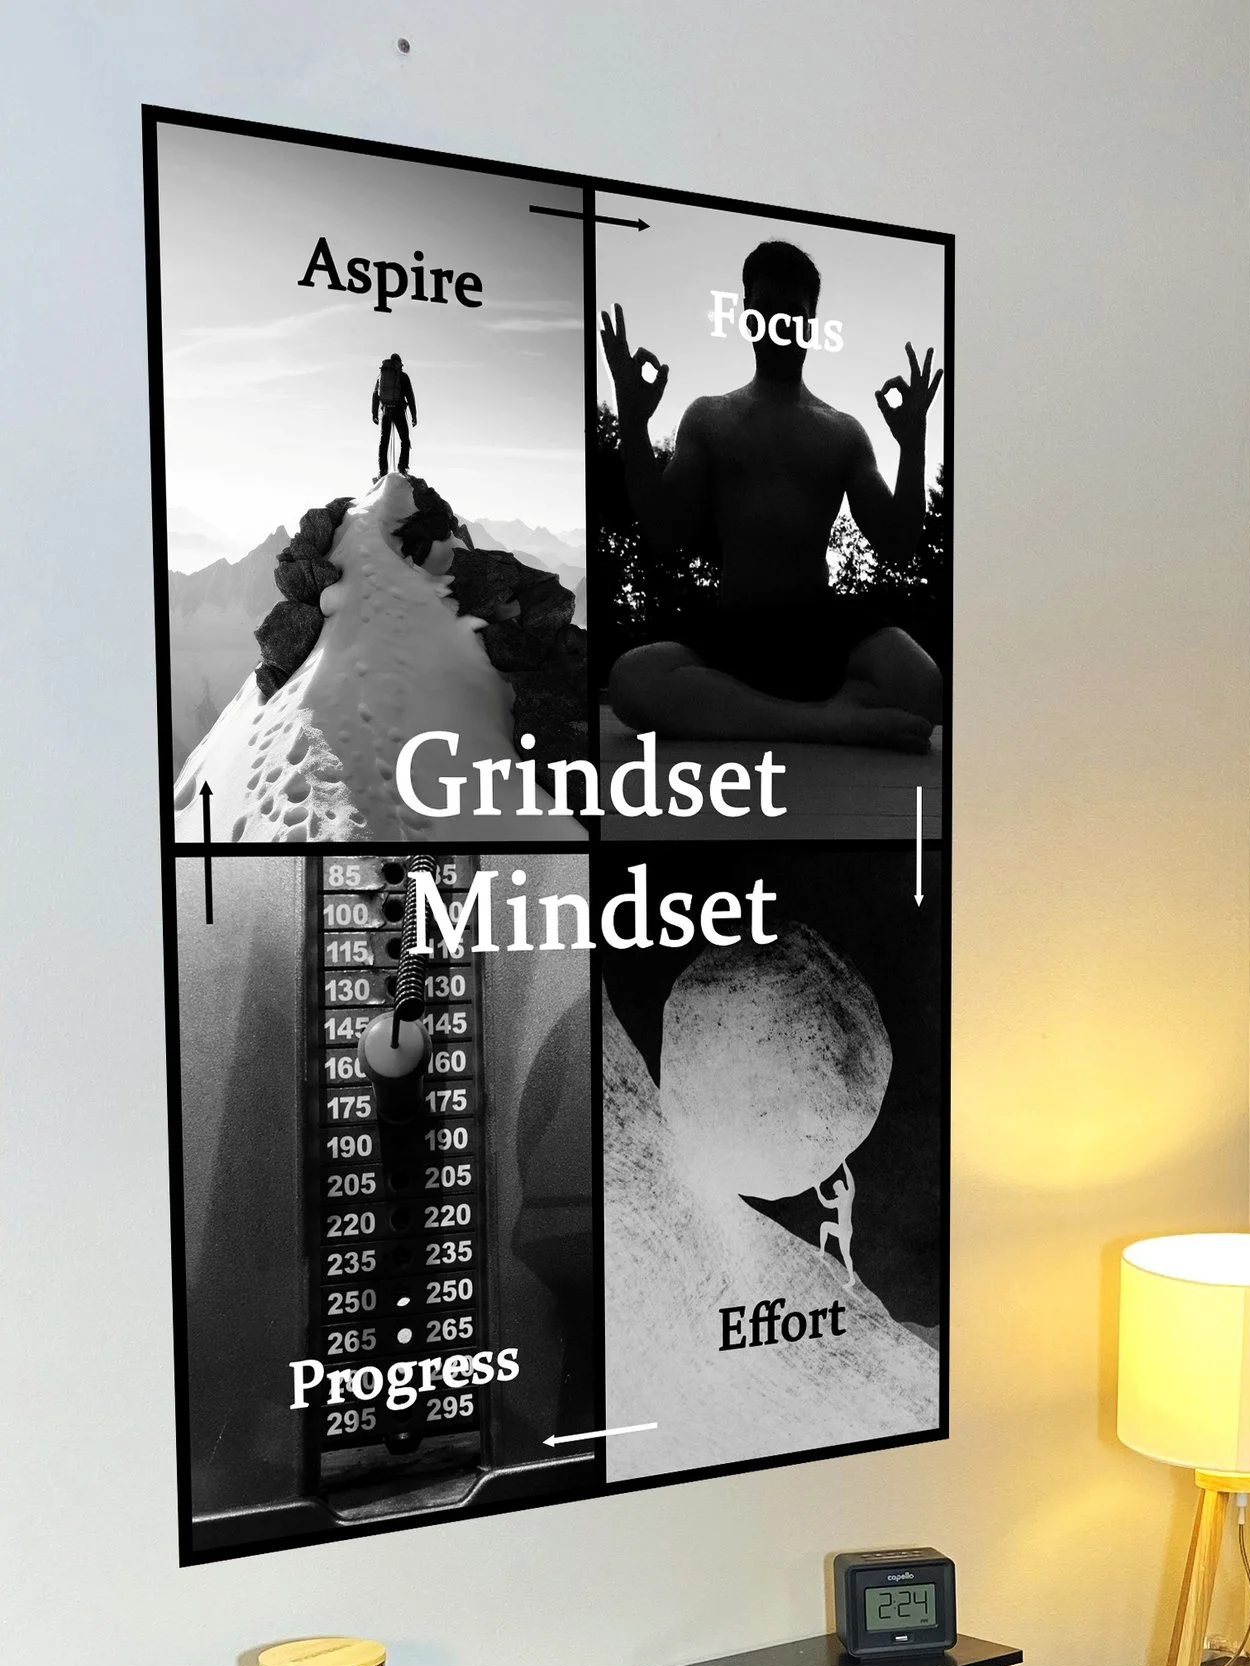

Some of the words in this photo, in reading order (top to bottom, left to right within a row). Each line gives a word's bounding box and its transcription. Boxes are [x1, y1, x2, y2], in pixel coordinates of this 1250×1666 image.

[298, 237, 483, 312] Aspire
[709, 290, 845, 353] Focus
[395, 730, 788, 818] Grindset
[328, 864, 362, 887] 85
[323, 903, 369, 926] 100
[407, 863, 778, 955] Mindset
[326, 941, 369, 963] 115
[324, 978, 370, 1001] 130
[424, 975, 466, 998] 130
[422, 1012, 468, 1036] 145
[327, 1095, 372, 1120] 175
[424, 1089, 468, 1113] 175
[326, 1133, 373, 1159] 190
[424, 1127, 469, 1151] 190
[327, 1172, 377, 1198] 205
[424, 1164, 472, 1189] 205
[326, 1211, 376, 1238] 220
[424, 1203, 471, 1229] 220
[327, 1250, 377, 1276] 235
[425, 1240, 473, 1266] 235
[327, 1288, 377, 1316] 250
[425, 1278, 474, 1304] 250
[425, 1316, 474, 1343] 265
[718, 1298, 847, 1352] Effort
[327, 1328, 377, 1355] 265
[289, 1348, 520, 1411] Progress
[426, 1393, 475, 1421] 295
[326, 1407, 377, 1436] 295
[887, 1572, 914, 1581] capello
[879, 1591, 928, 1619] 2:24
